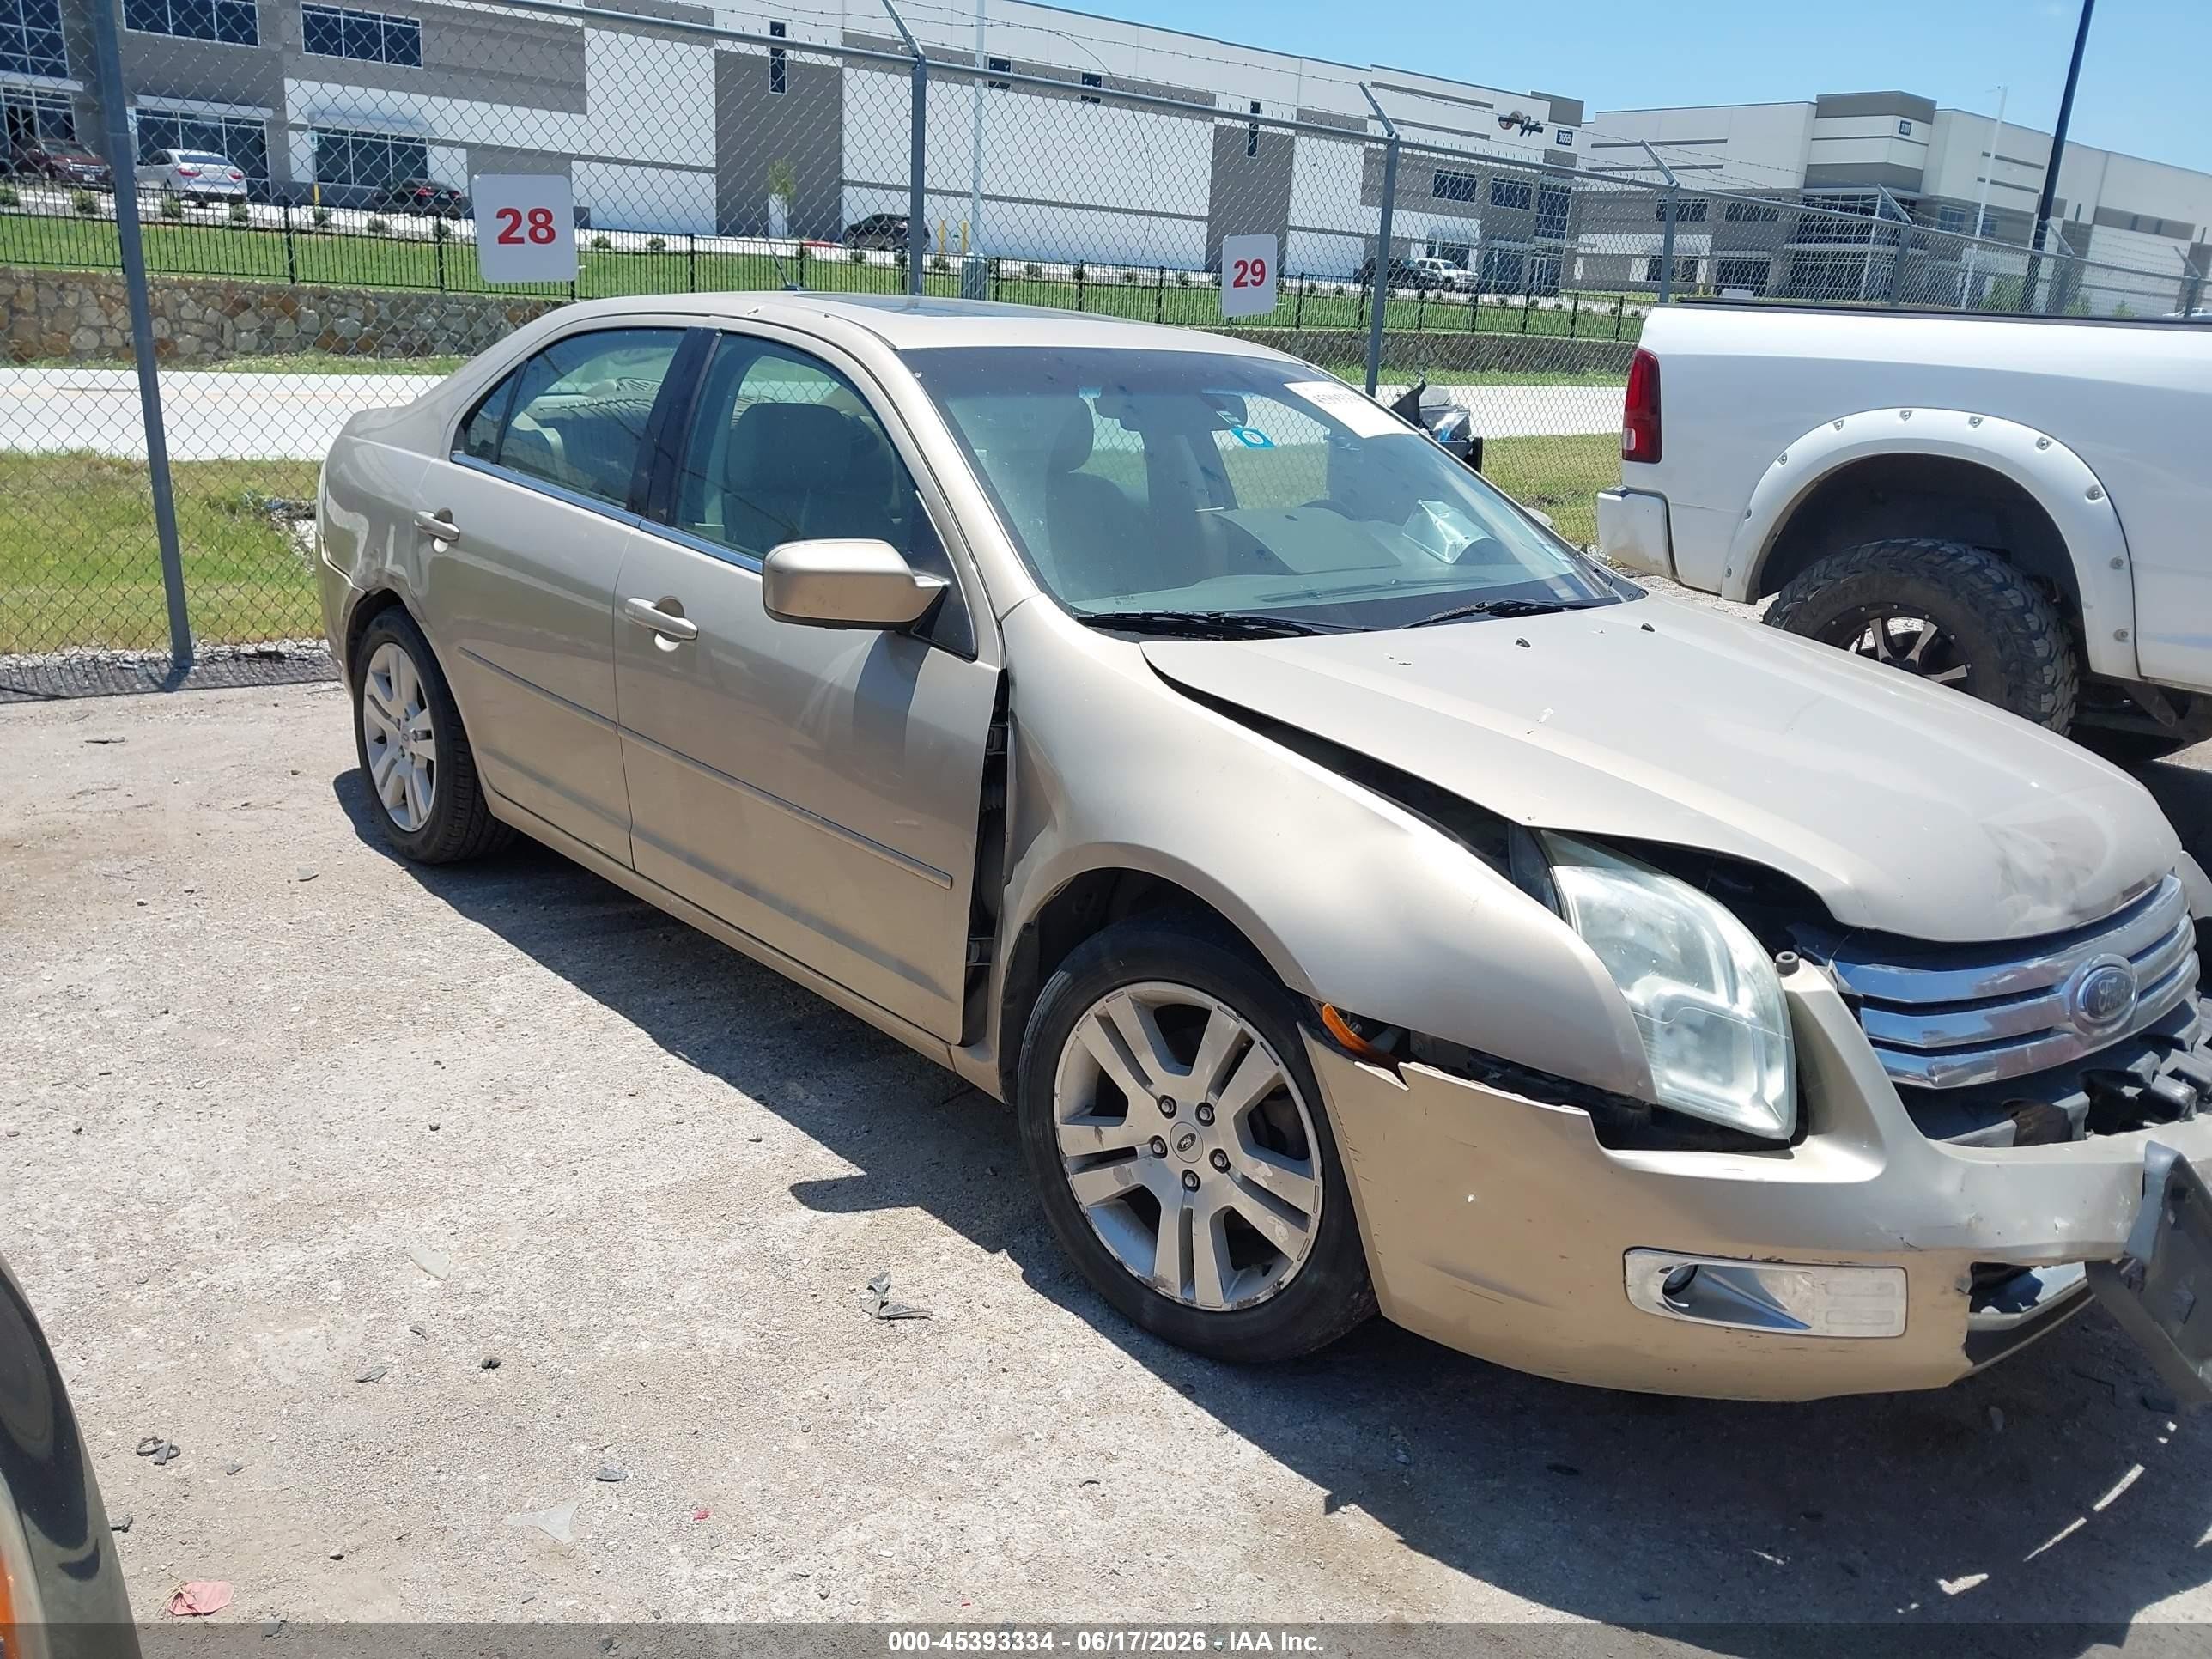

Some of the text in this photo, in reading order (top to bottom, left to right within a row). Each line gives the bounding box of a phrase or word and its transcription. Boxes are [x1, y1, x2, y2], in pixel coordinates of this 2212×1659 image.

[1558, 131, 1572, 143] 3655
[495, 208, 555, 245] 28
[1232, 258, 1267, 289] 29
[2098, 976, 2127, 1012] Ford
